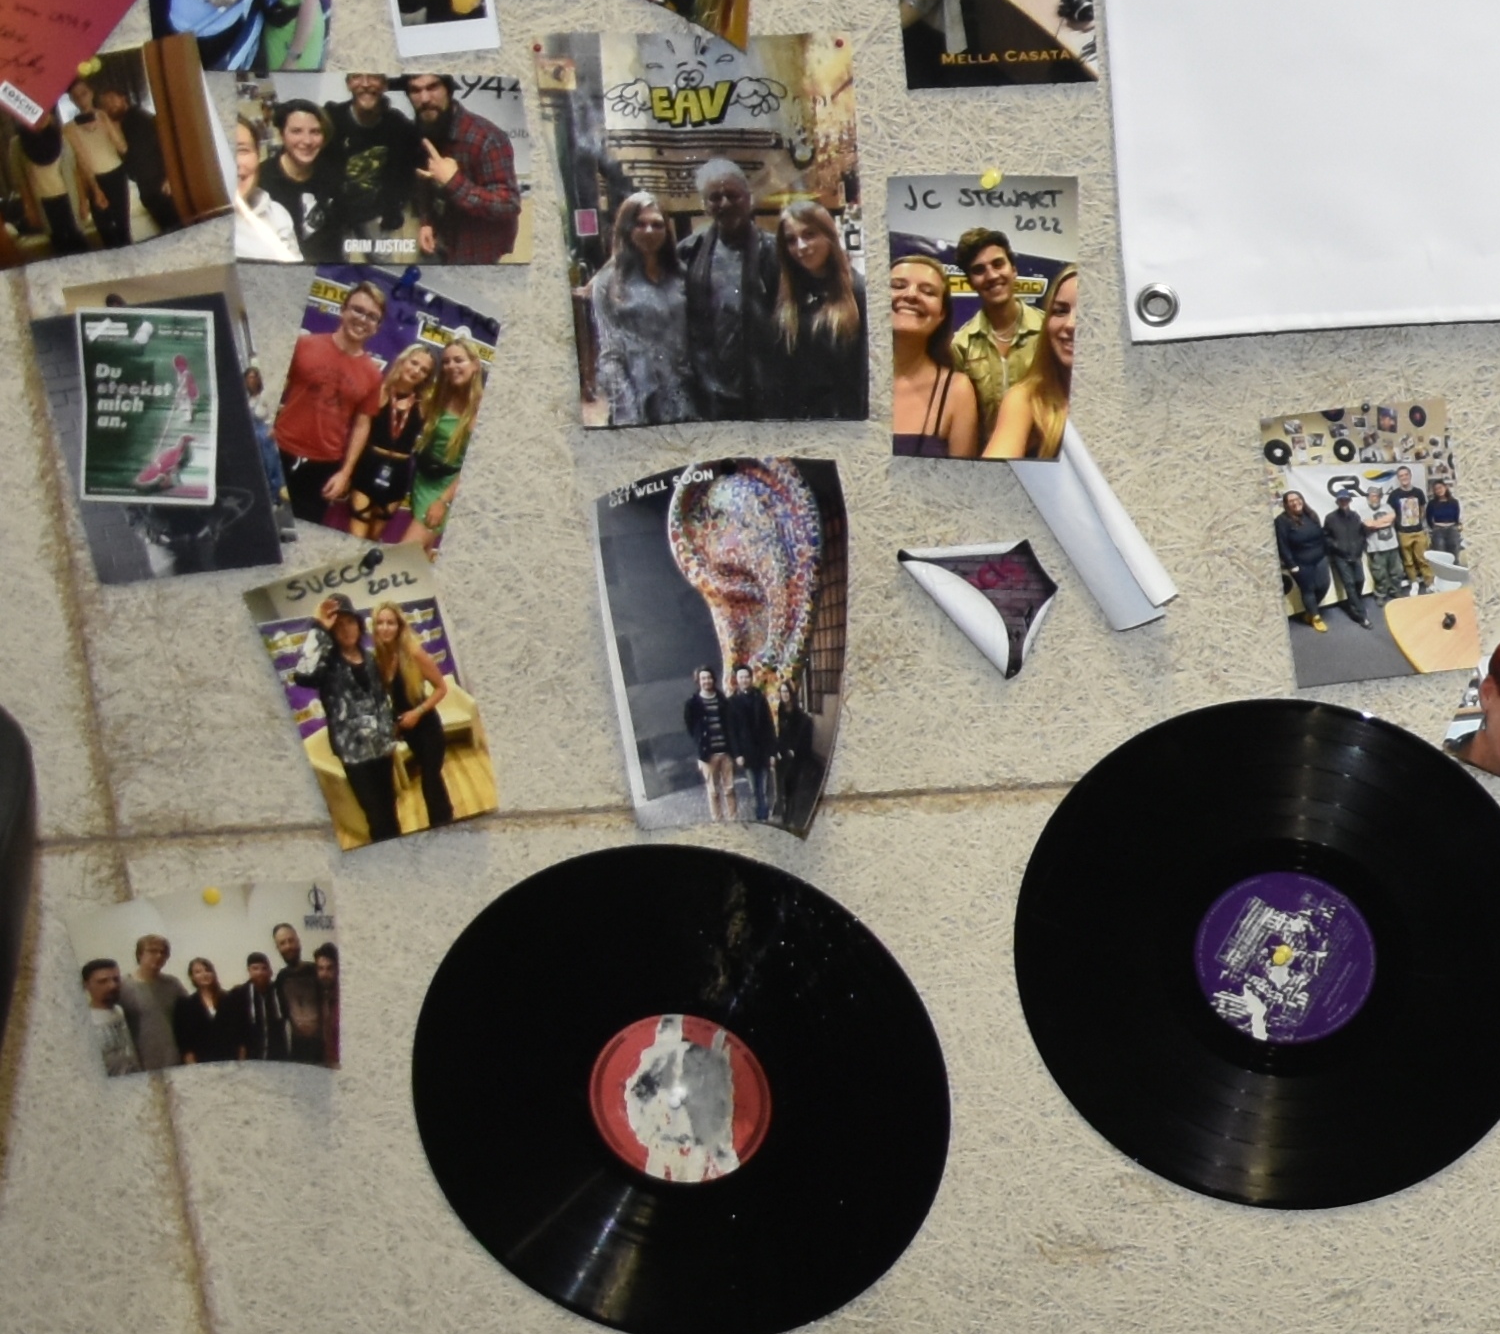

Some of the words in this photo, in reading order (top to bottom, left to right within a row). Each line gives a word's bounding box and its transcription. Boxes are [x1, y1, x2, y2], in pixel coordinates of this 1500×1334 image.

[941, 51, 999, 66] MELLA
[1004, 49, 1072, 64] CASATA
[650, 78, 737, 128] EAV
[905, 185, 943, 211] JC
[1014, 214, 1063, 234] 2022
[672, 468, 715, 490] SOON
